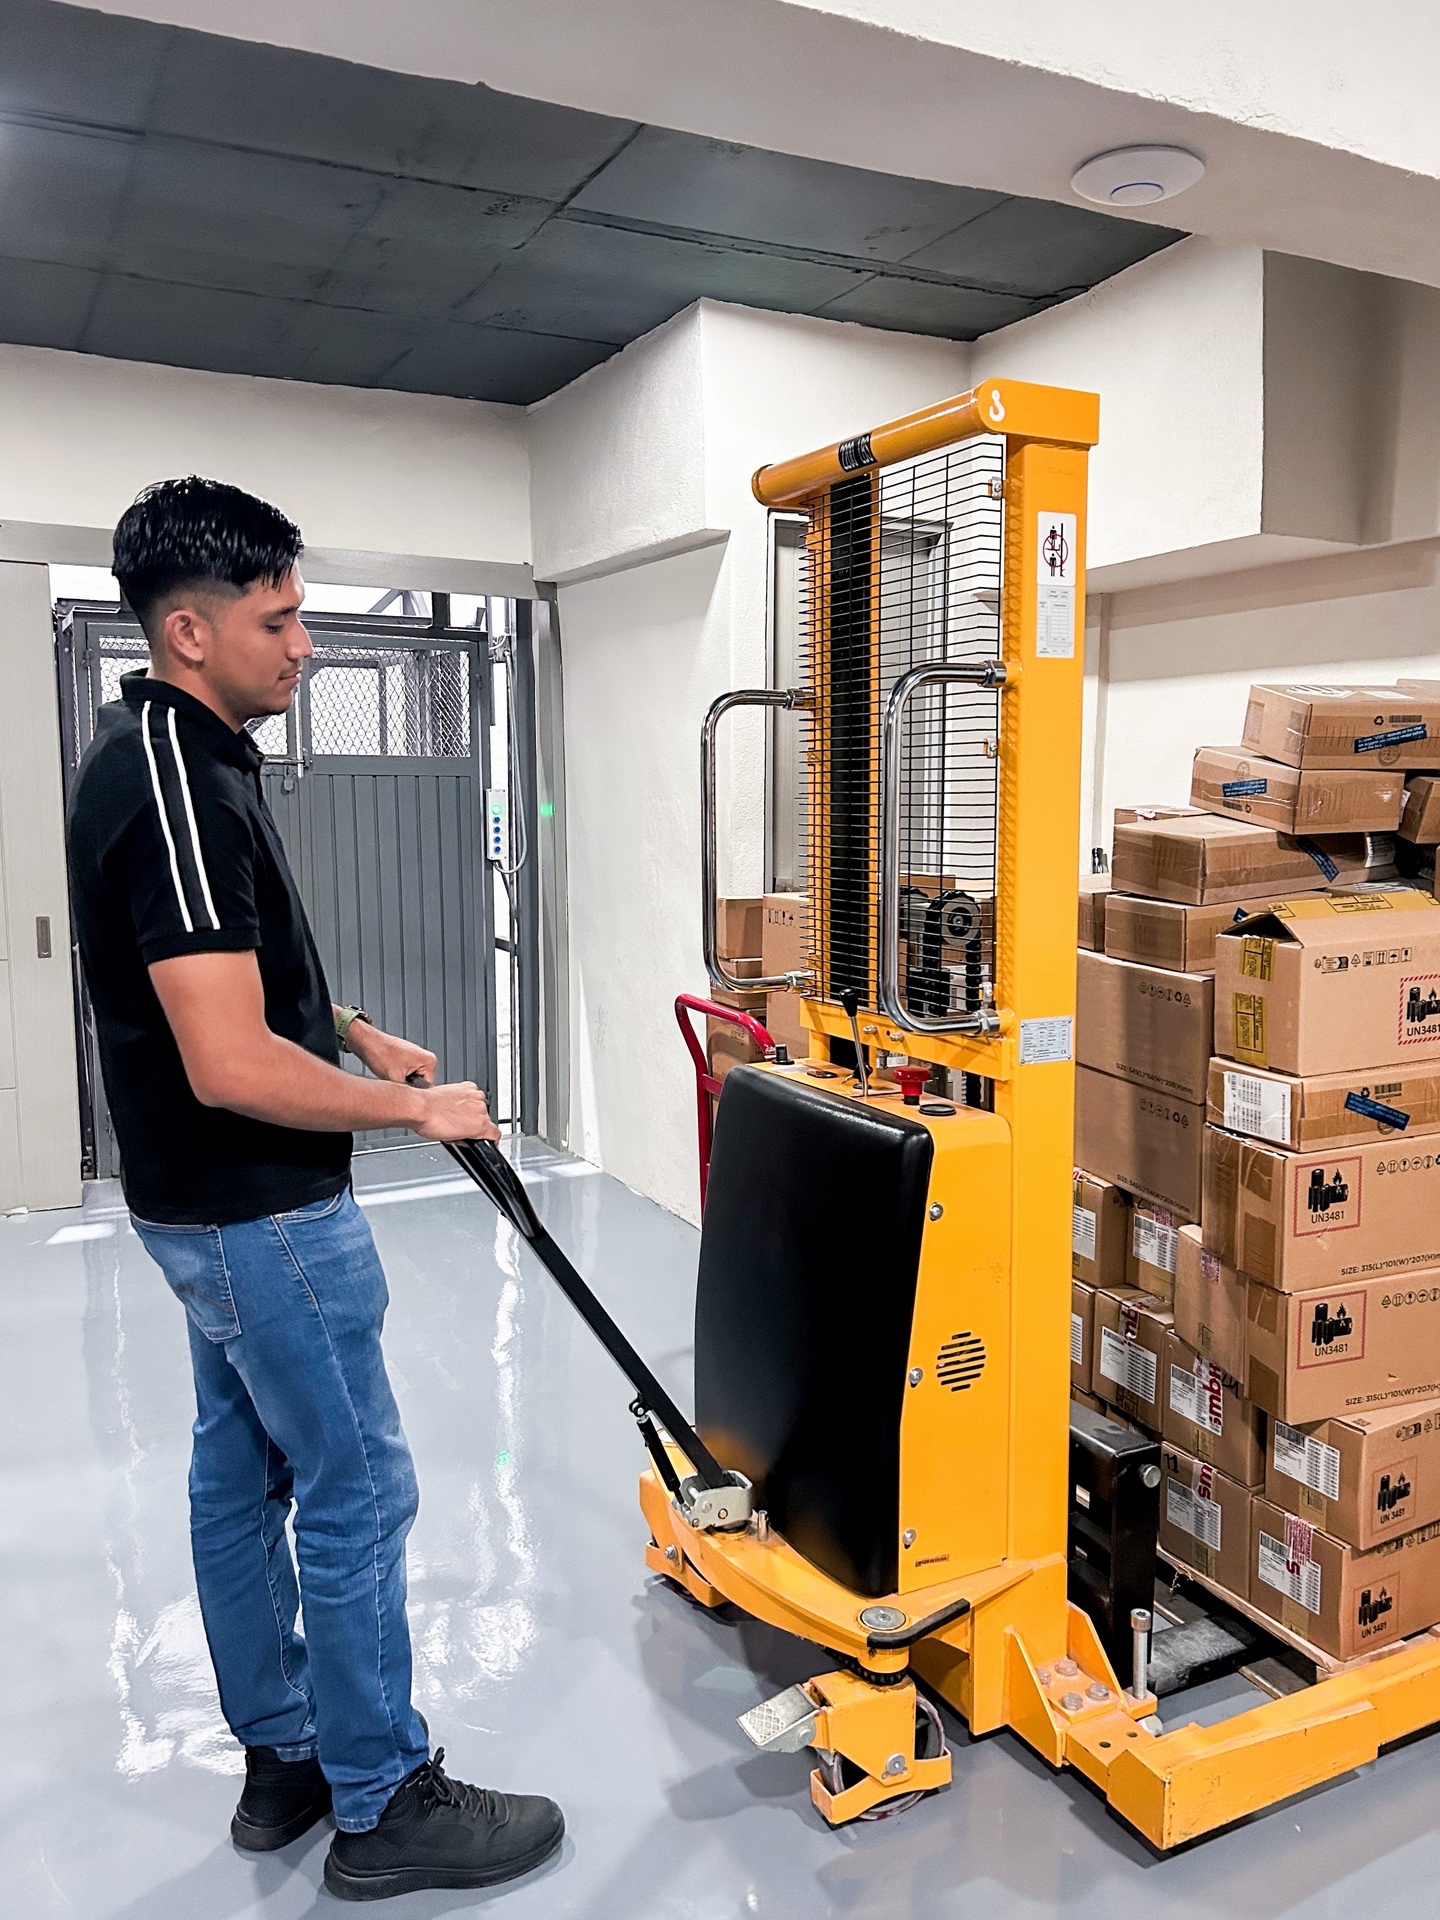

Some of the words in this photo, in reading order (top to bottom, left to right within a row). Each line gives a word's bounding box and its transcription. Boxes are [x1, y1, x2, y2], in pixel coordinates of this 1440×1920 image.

[1311, 1210, 1345, 1224] UN3481
[1341, 1266, 1359, 1276] SIZE:
[1314, 1343, 1348, 1357] UN3481
[1345, 1396, 1364, 1406] SIZE:
[1380, 1512, 1390, 1524] UN
[1391, 1507, 1405, 1520] 3481
[1361, 1627, 1371, 1639] UN
[1373, 1621, 1387, 1634] 3481
